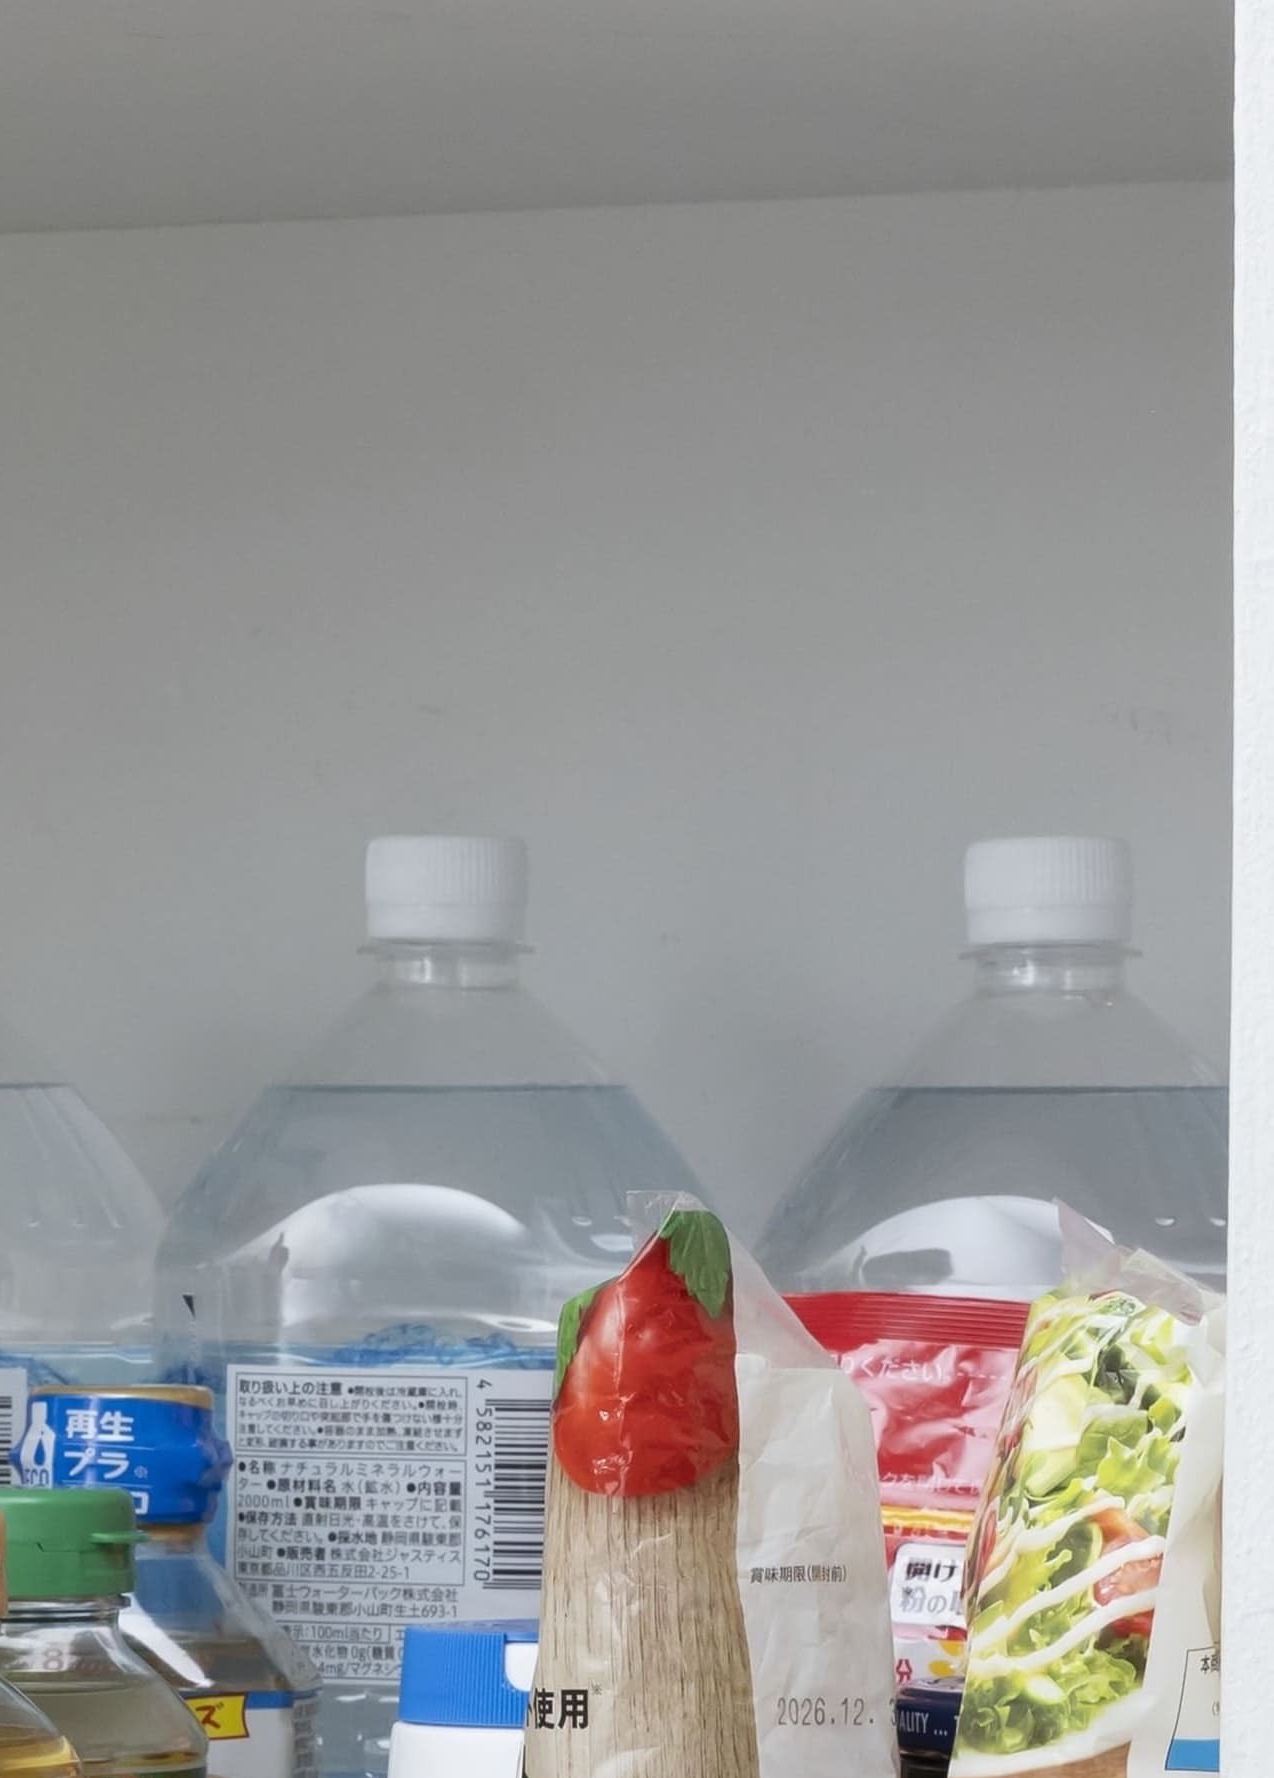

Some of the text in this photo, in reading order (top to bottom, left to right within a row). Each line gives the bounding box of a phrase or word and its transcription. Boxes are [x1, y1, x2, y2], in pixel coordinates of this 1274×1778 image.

[239, 1379, 343, 1396] 取り扱い上の注意
[65, 1408, 135, 1442] 再生
[63, 1447, 131, 1480] プラ
[248, 1460, 462, 1477] 名称 ナチュラルミネラルウォー
[277, 1478, 337, 1493] 原材料名
[417, 1481, 462, 1496] 内容量
[473, 1379, 493, 1582] 4 582151 176170
[304, 1495, 362, 1510] 賞味期限
[244, 1511, 298, 1526] 保存方法
[337, 1530, 378, 1545] 採水地
[285, 1546, 327, 1561] 販売者
